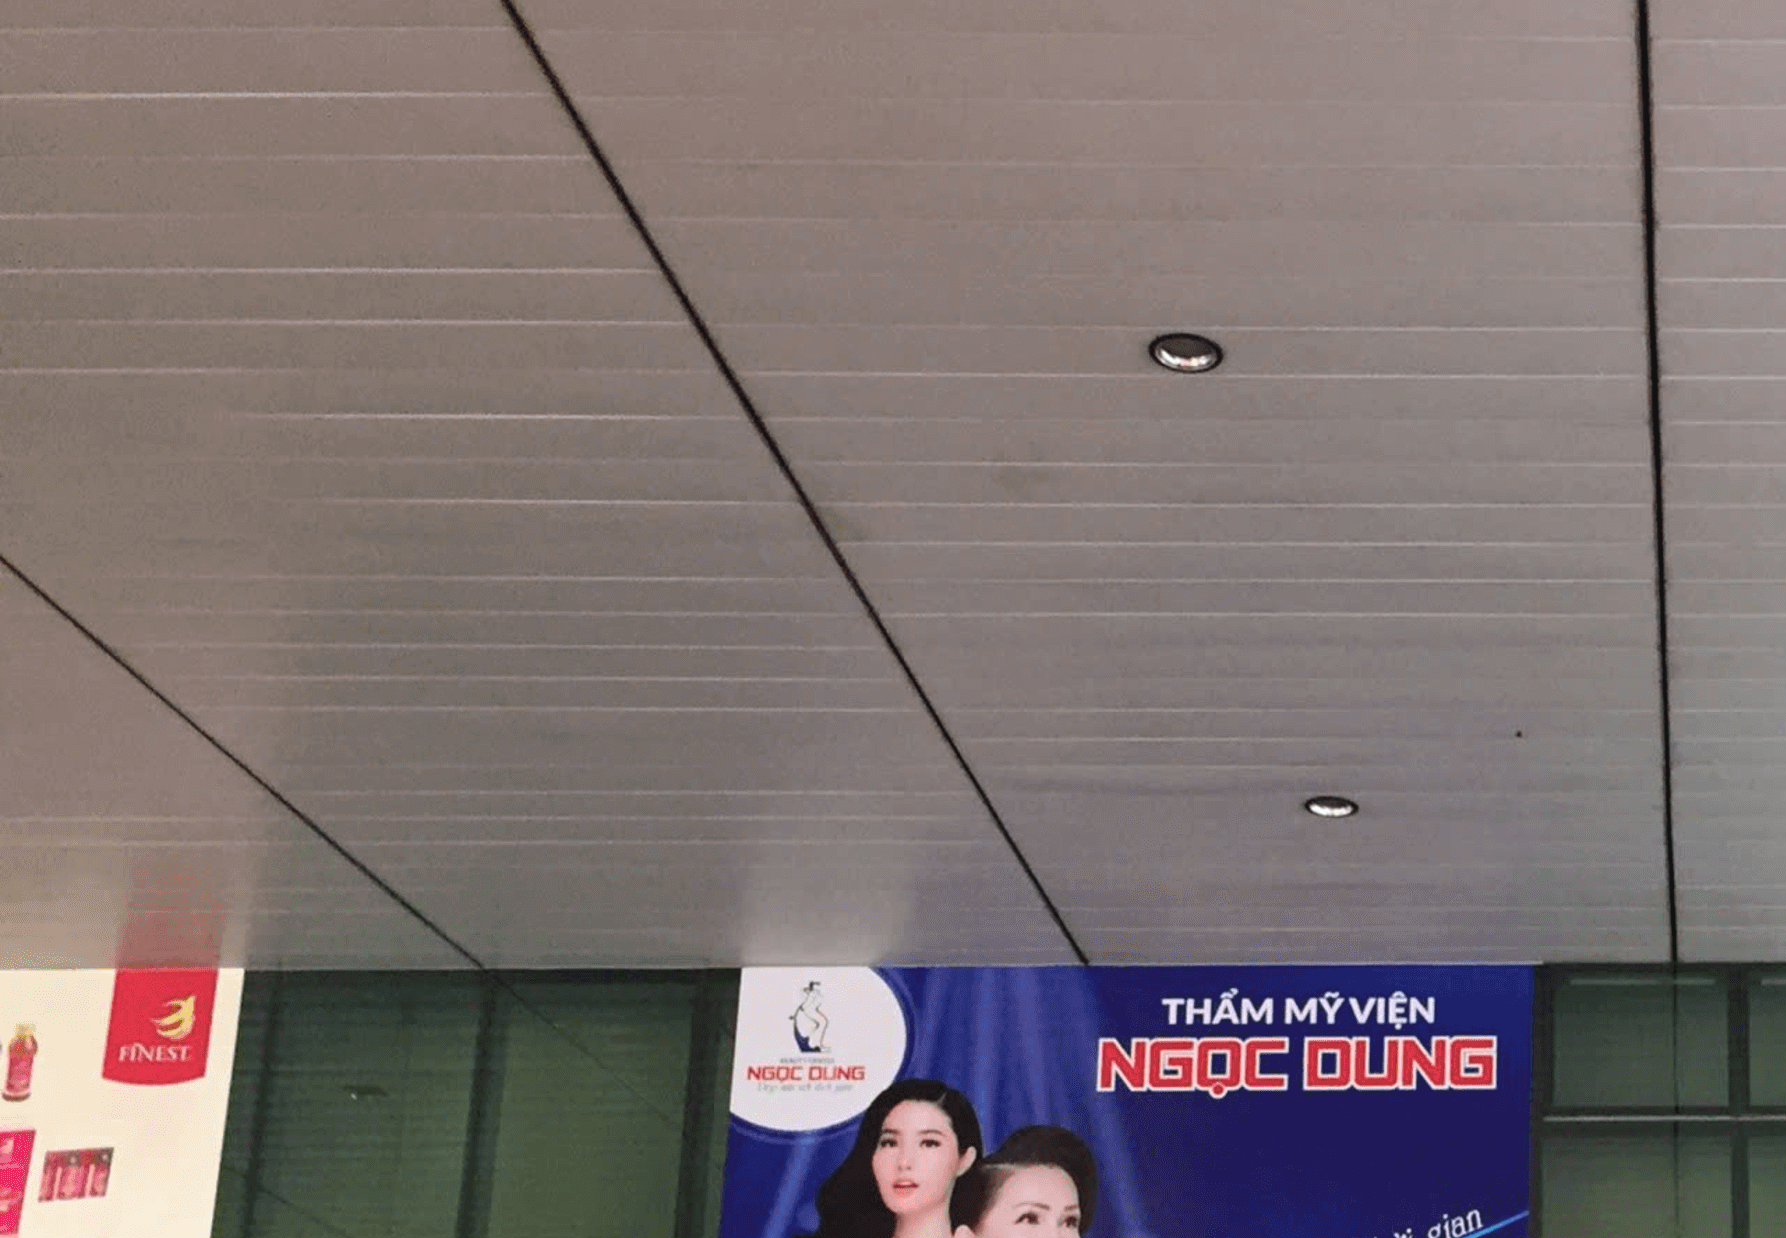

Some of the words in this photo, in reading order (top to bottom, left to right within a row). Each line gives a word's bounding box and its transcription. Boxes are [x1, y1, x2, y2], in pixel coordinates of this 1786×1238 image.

[1162, 988, 1274, 1025] THẨM
[1285, 991, 1340, 1025] MỸ
[1349, 991, 1435, 1030] VIỆN
[119, 1043, 191, 1062] FINEST
[1096, 1036, 1289, 1099] NGỌC
[1303, 1035, 1498, 1090] DUNG
[808, 1065, 866, 1081] DUNG
